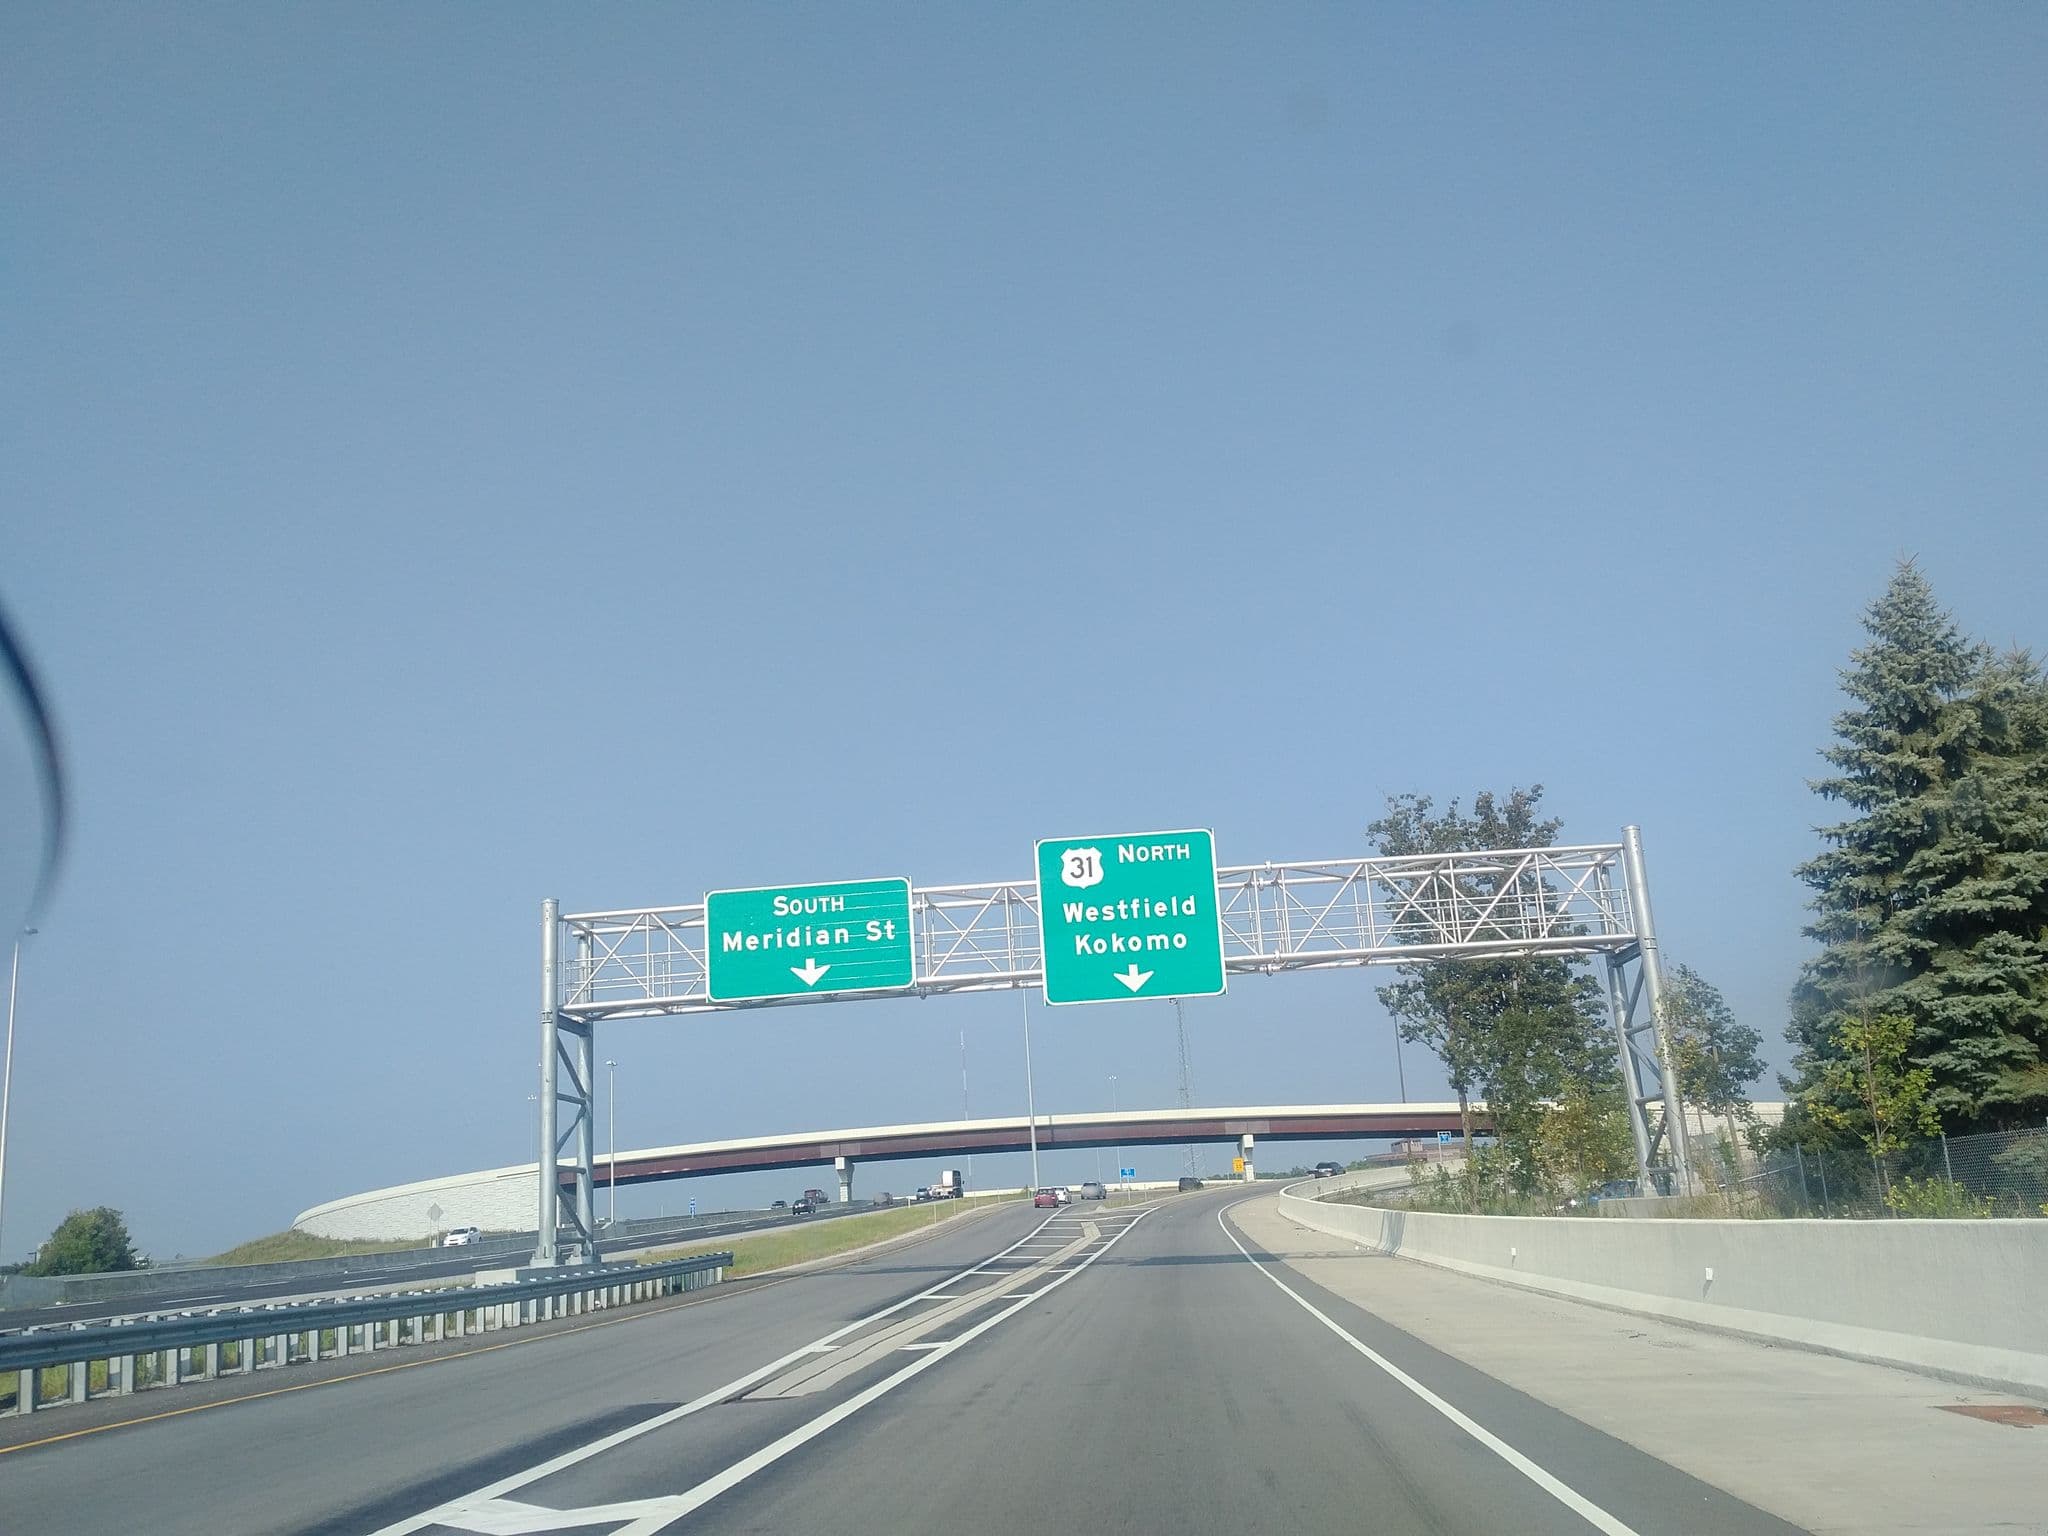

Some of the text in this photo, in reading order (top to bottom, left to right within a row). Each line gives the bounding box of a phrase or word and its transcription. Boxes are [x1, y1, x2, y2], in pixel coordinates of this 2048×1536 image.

[1070, 844, 1190, 879] 31 NORTH
[773, 895, 845, 917] SOUTH
[1062, 895, 1196, 923] Westfield
[722, 920, 896, 953] Meridian St
[1075, 933, 1187, 956] Kokomo
